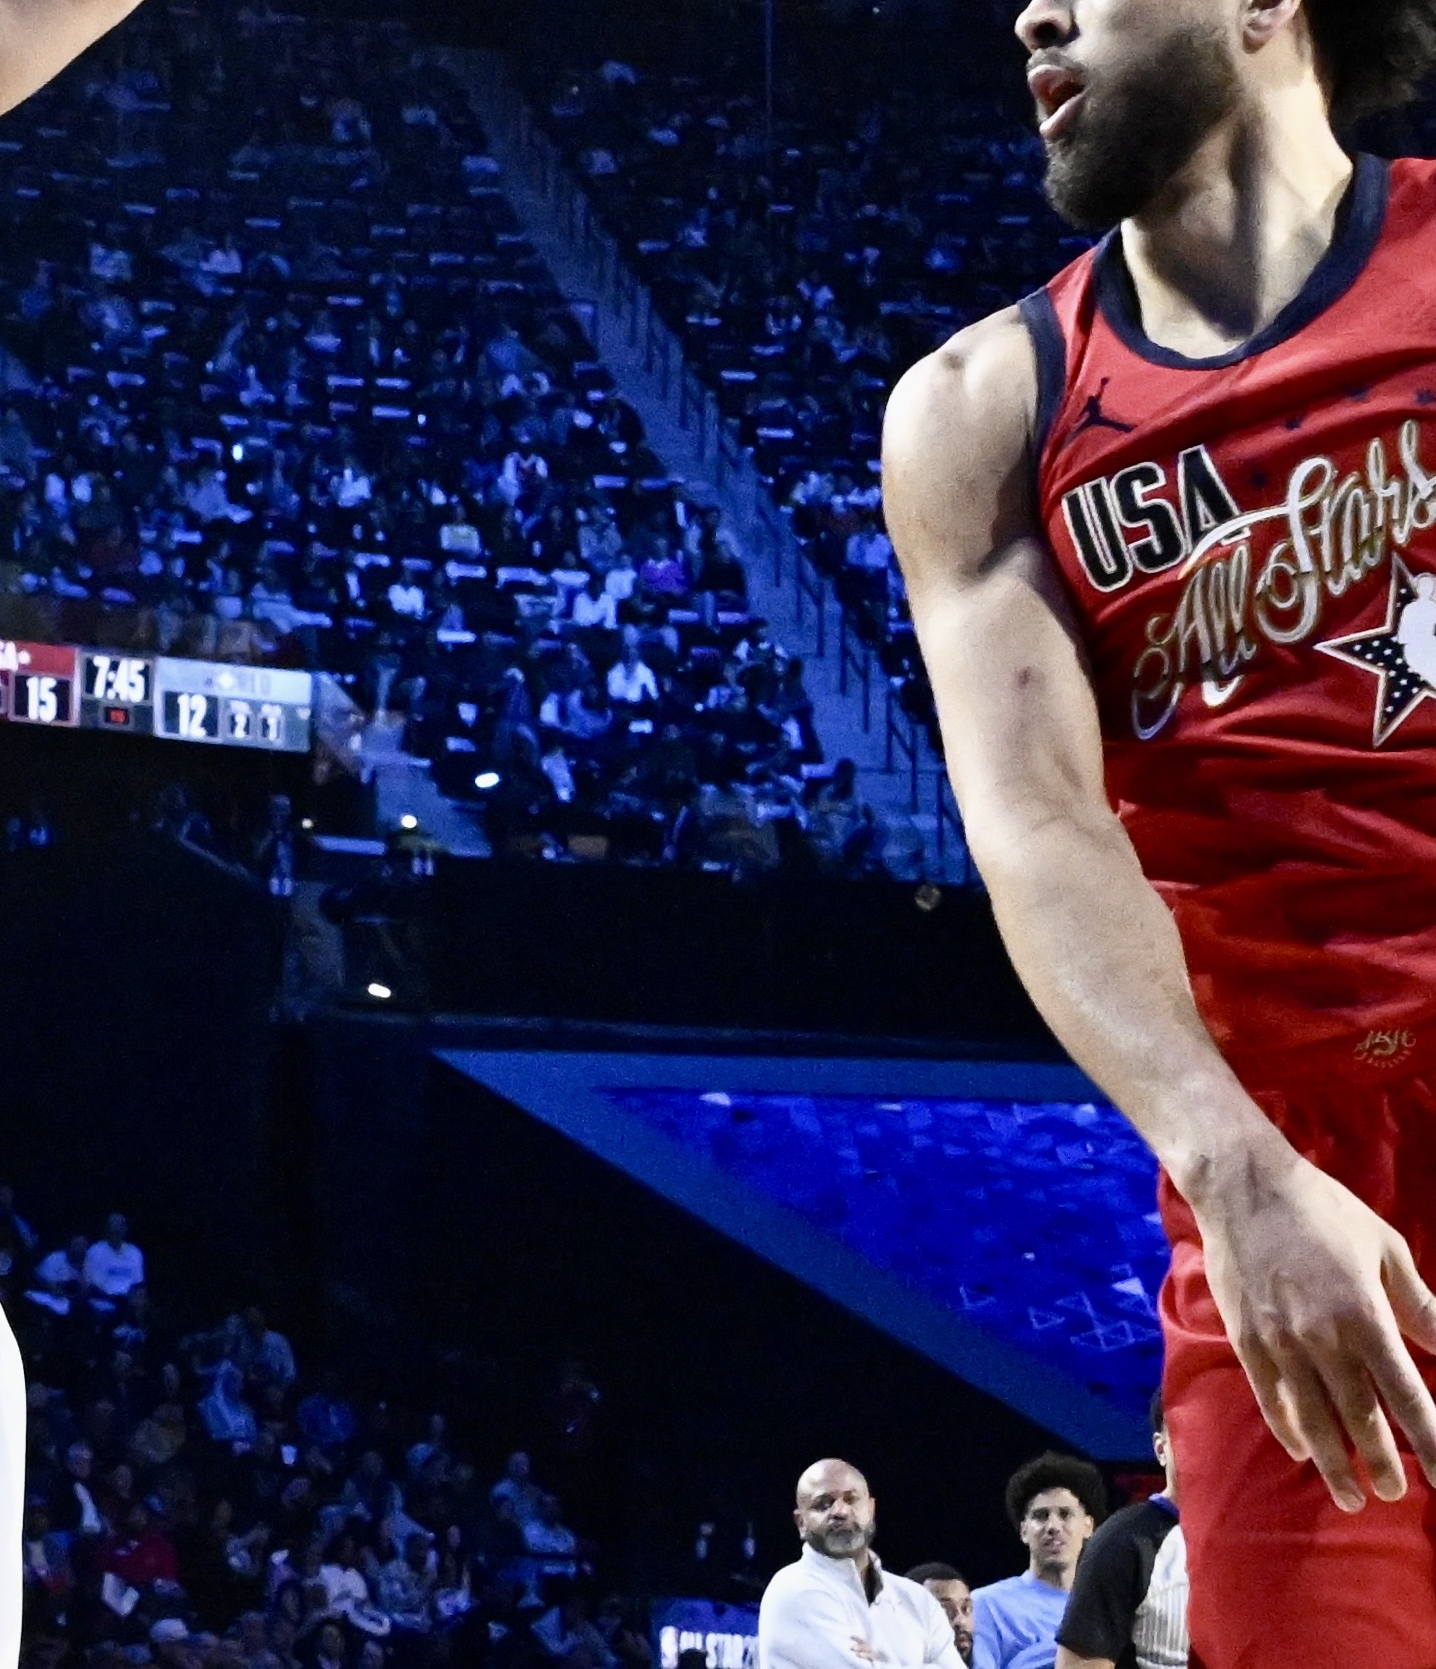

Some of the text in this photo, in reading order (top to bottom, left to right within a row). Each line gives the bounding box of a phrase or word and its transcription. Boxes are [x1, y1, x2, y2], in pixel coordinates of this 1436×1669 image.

[1061, 443, 1251, 593] USA
[26, 676, 58, 723] 15
[92, 655, 147, 703] 7:45
[177, 693, 208, 739] 12
